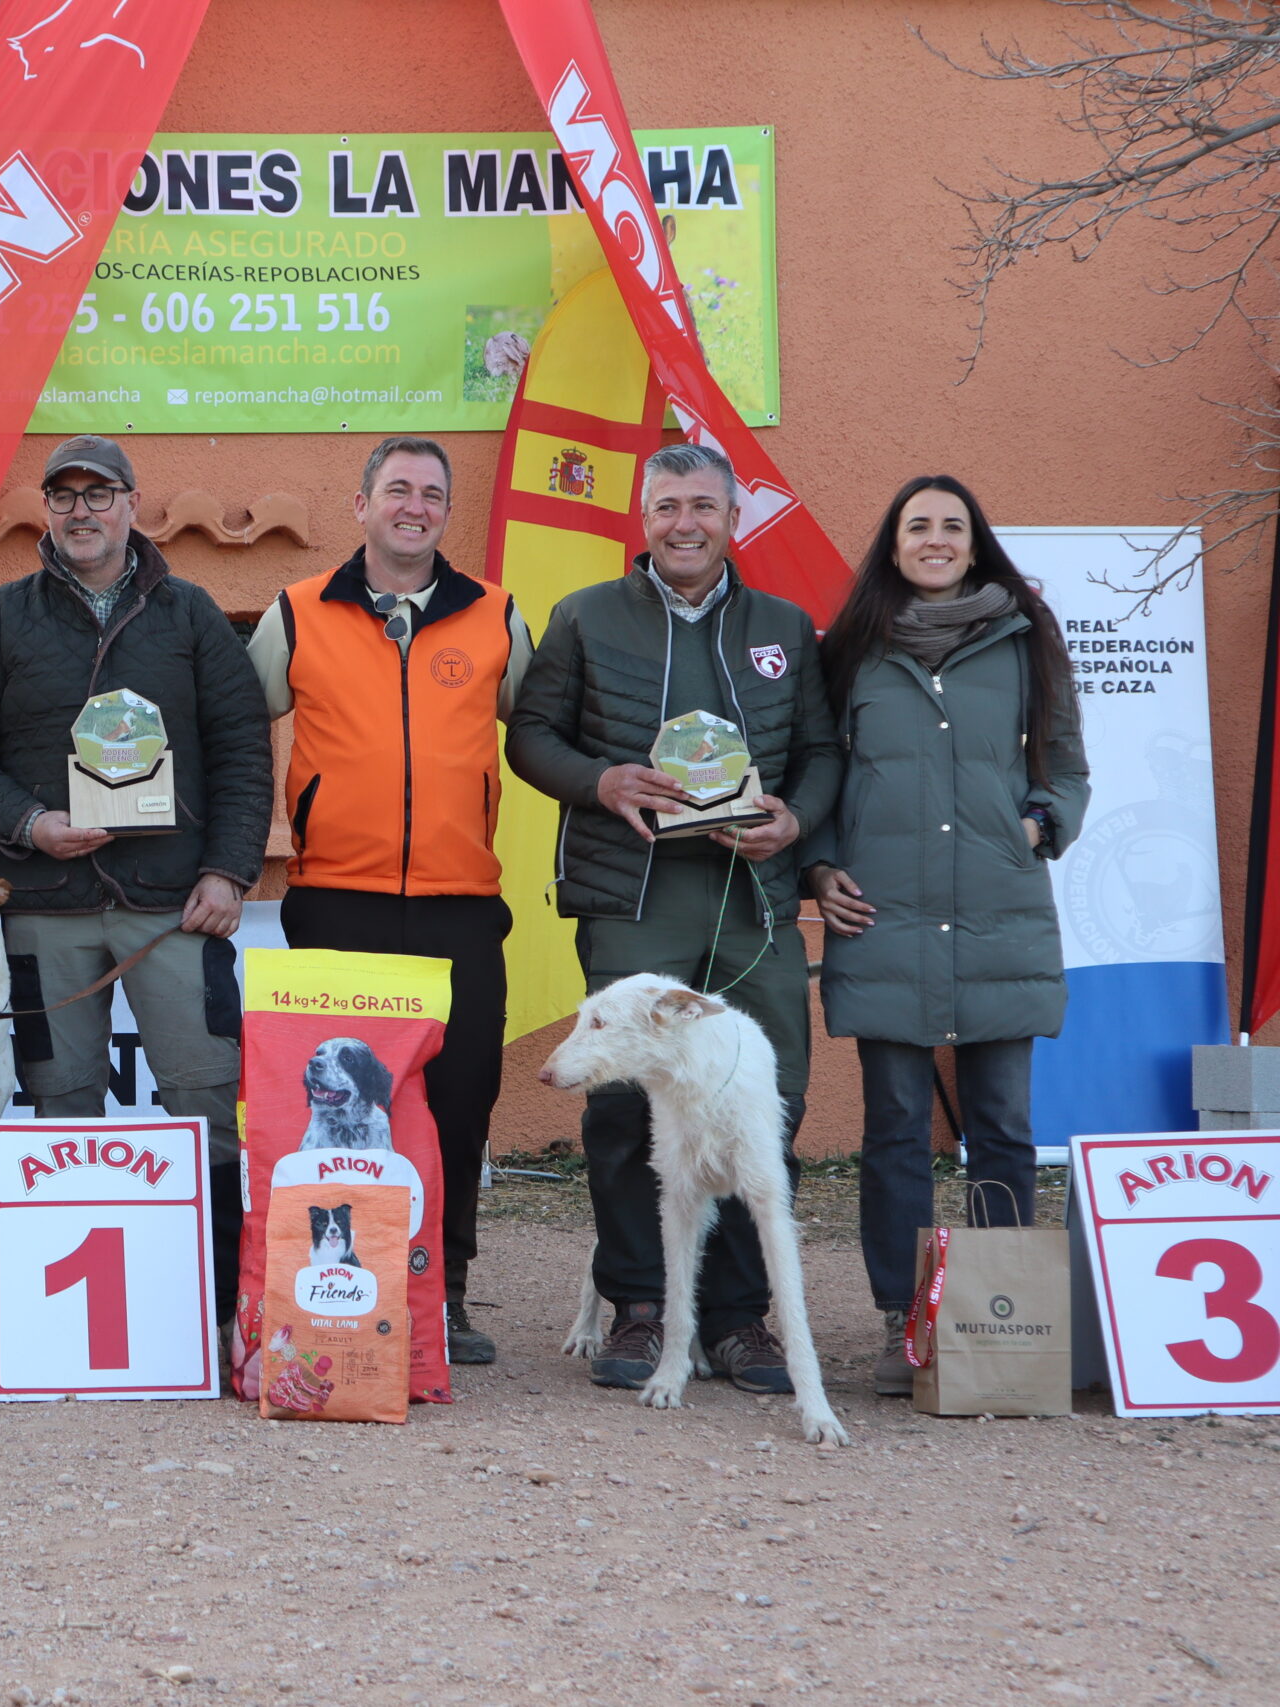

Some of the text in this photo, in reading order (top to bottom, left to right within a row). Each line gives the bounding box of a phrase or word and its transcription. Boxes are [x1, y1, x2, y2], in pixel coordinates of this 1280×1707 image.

[333, 154, 415, 213] LA
[447, 149, 738, 212] MANHA
[183, 229, 407, 258] ASEGURADO
[141, 292, 215, 333] 606
[229, 293, 302, 332] 251
[317, 292, 390, 332] 516
[195, 385, 443, 408] repomancha@hotmail.com
[1066, 620, 1119, 633] REAL
[1067, 637, 1195, 654] FEDERACIÓN
[1070, 656, 1173, 674] ESPAÑOLA
[1101, 680, 1157, 694] CAZA
[333, 998, 348, 1010] kg
[352, 994, 424, 1013] GRATIS
[20, 1138, 171, 1191] ARION
[317, 1156, 384, 1179] ARION
[1119, 1152, 1272, 1206] ARION
[319, 1267, 354, 1281] ARION
[45, 1227, 130, 1370] 1
[310, 1283, 370, 1302] Friends
[1156, 1238, 1280, 1383] 3
[311, 1318, 359, 1329] VITAL LAMB
[954, 1322, 1053, 1336] MUTUASPORT
